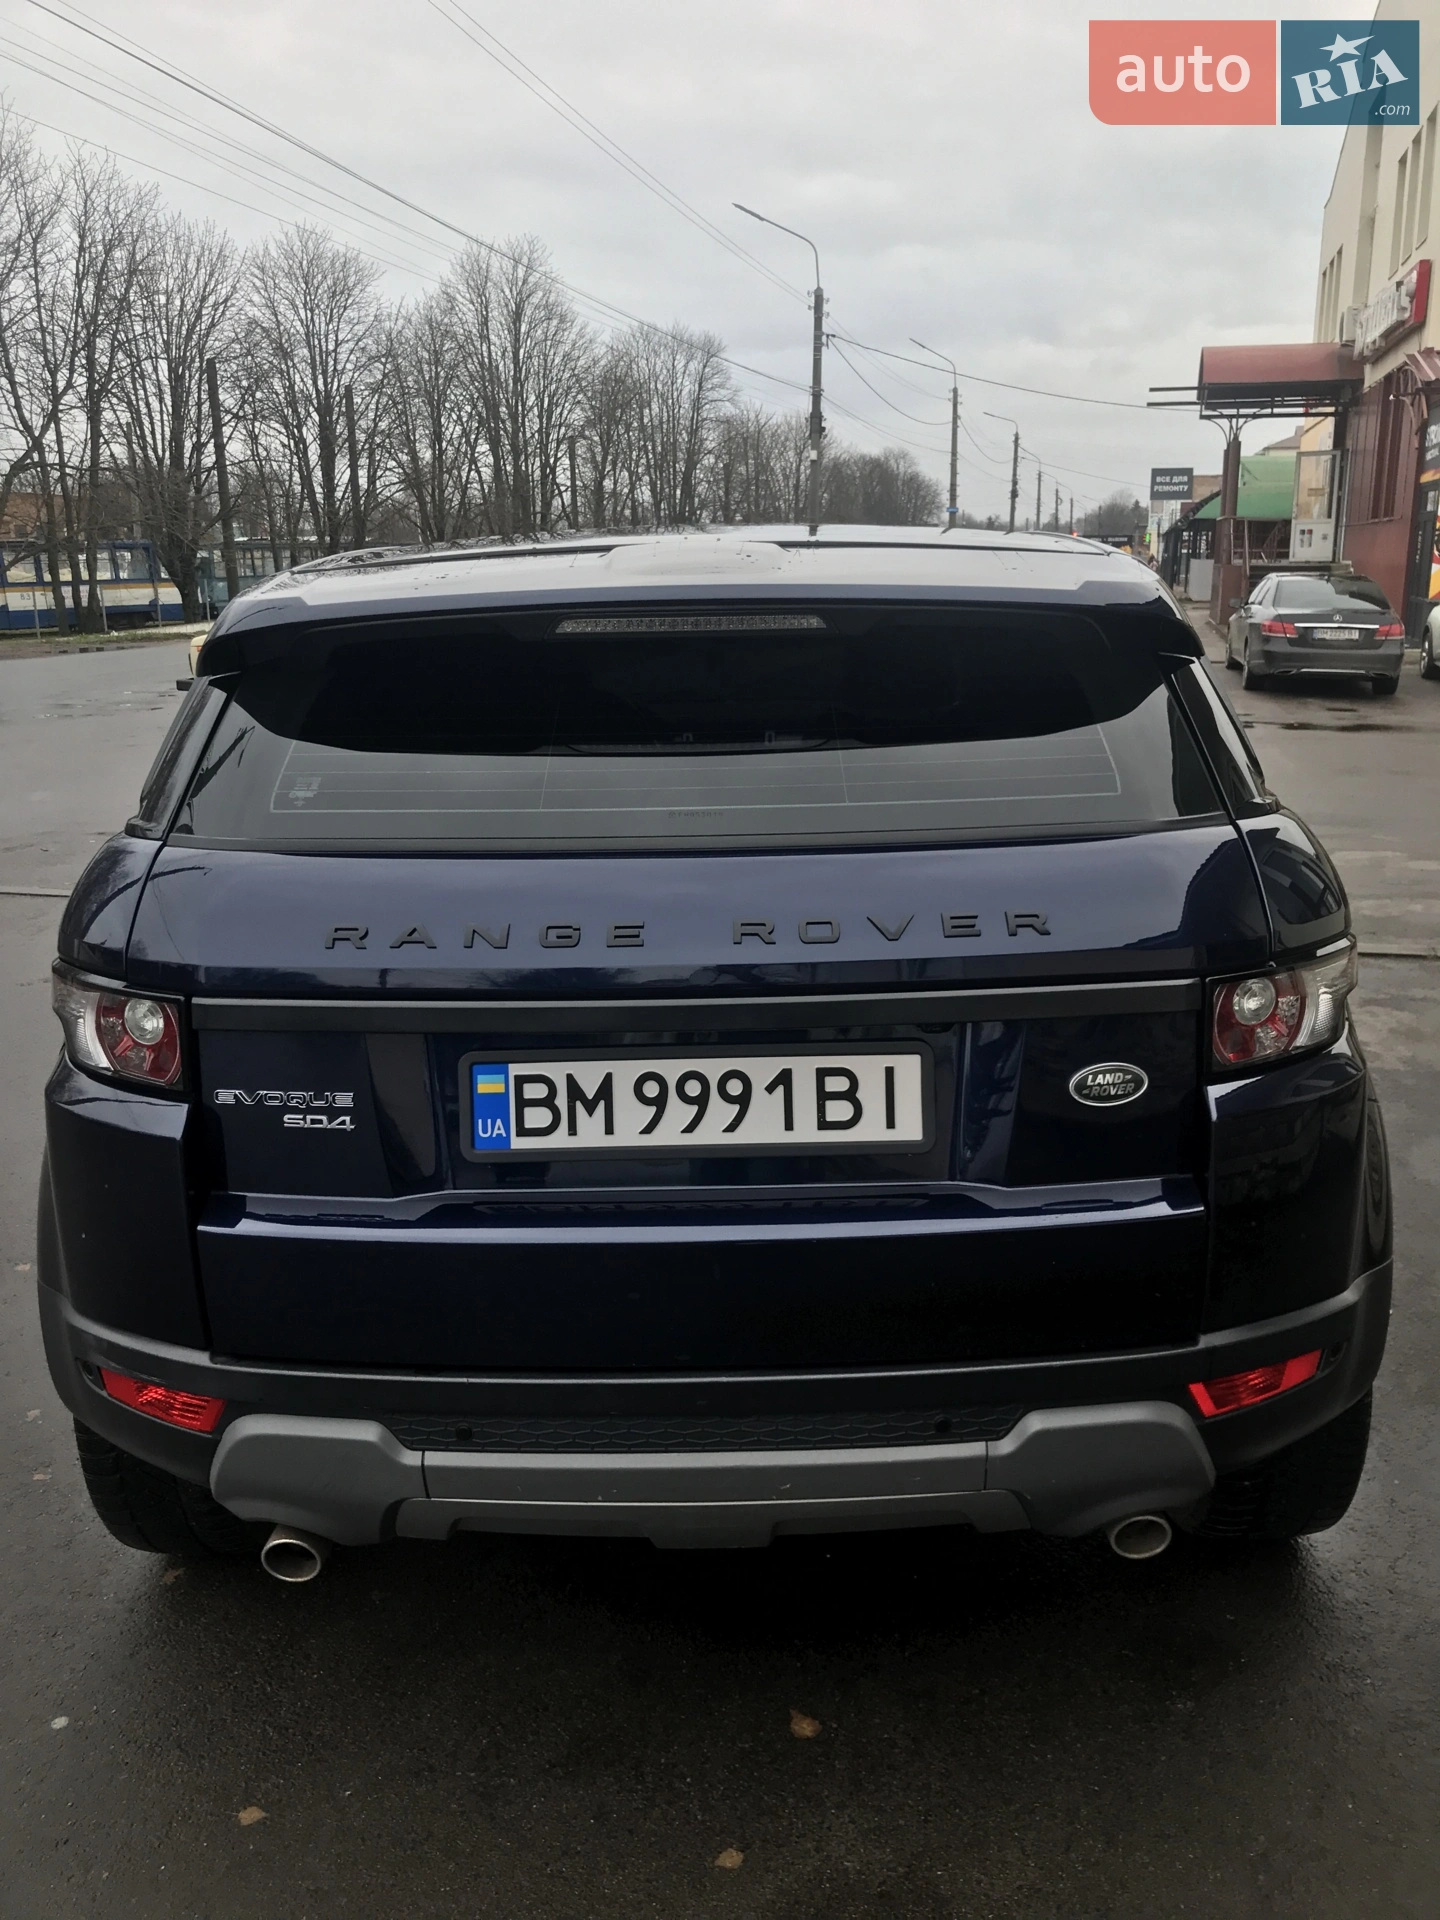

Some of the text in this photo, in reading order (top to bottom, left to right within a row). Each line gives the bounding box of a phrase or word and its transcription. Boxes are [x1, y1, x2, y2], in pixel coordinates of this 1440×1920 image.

[1156, 475, 1188, 483] ВСЕ ДЛЯ
[324, 910, 1052, 950] RANGE ROVER
[1086, 1072, 1124, 1086] LAND
[213, 1089, 354, 1109] EVOQUE
[1090, 1083, 1135, 1097] ROVER
[282, 1113, 356, 1132] SD4
[478, 1118, 507, 1138] UA
